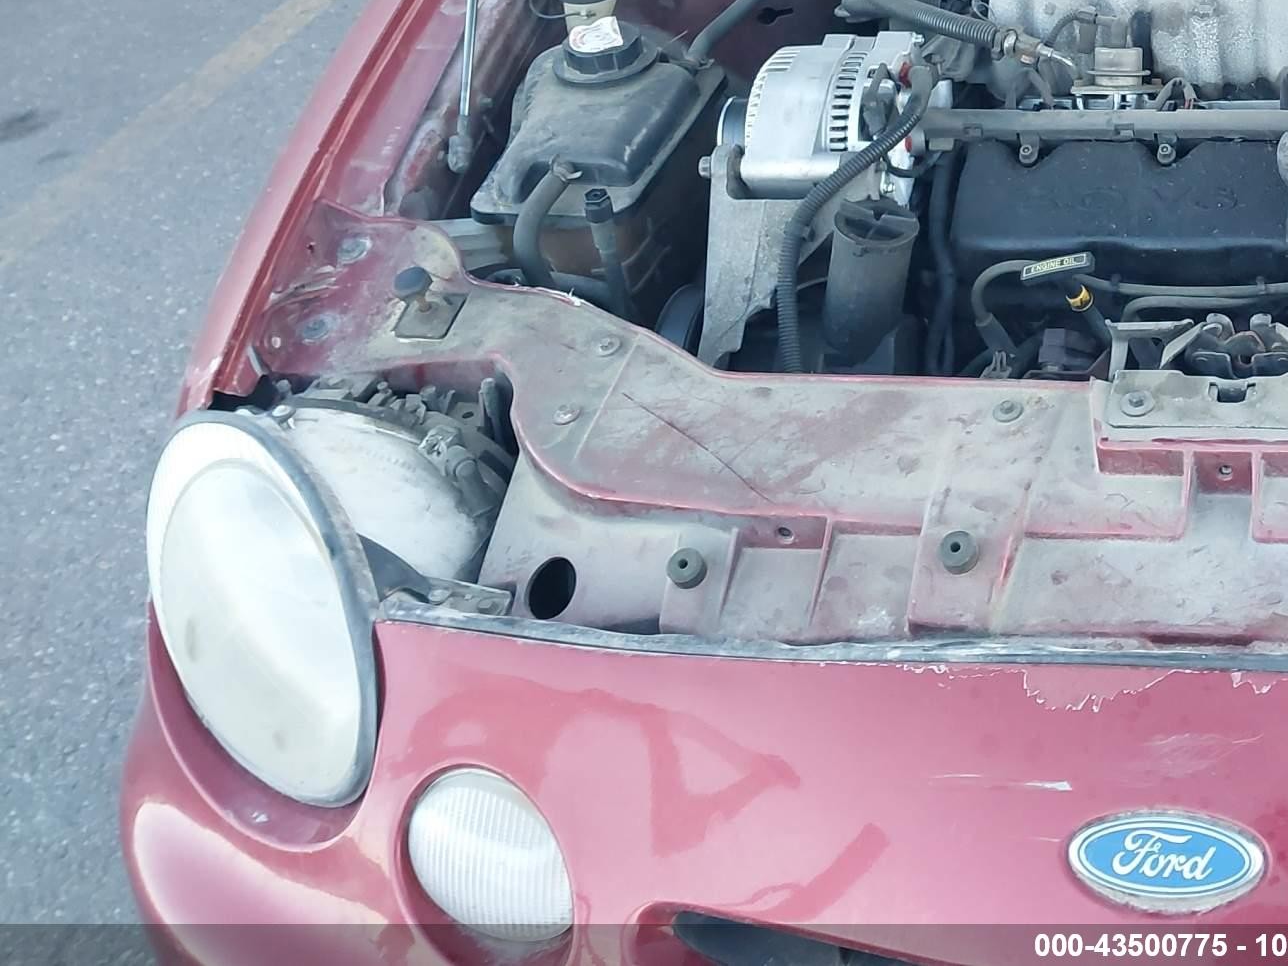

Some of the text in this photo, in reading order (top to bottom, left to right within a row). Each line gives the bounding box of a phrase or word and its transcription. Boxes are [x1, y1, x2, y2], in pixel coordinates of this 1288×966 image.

[1031, 258, 1075, 273] ENGINE OIL
[1112, 828, 1217, 881] Ford
